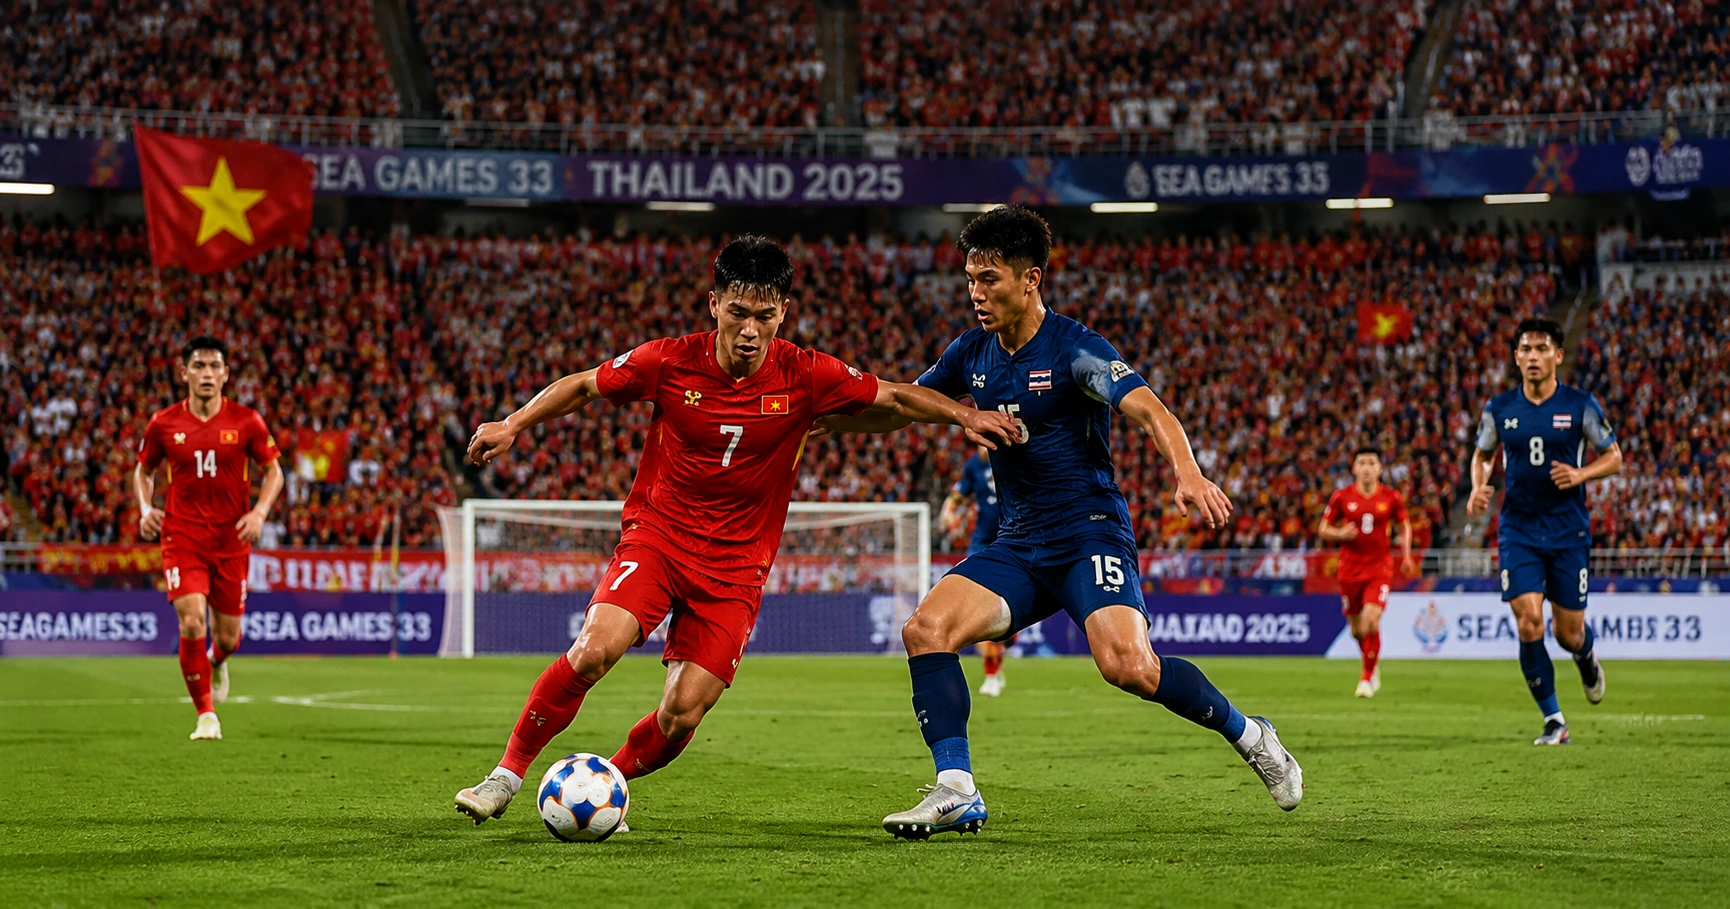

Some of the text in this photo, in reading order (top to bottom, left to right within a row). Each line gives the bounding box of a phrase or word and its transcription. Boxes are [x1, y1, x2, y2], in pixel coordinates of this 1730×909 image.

[373, 155, 499, 194] GAMES
[506, 159, 554, 195] 33
[587, 160, 904, 201] THAILAND 2025
[720, 425, 743, 467] 7
[1529, 436, 1545, 466] 8
[194, 449, 217, 478] 14
[609, 561, 639, 591] 7
[1091, 554, 1125, 586] 15
[1579, 568, 1588, 594] 8
[301, 611, 393, 641] GAMES
[397, 611, 431, 641] 33
[1245, 613, 1310, 643] 2025
[1457, 615, 1515, 642] SEA
[1664, 615, 1702, 642] 33
